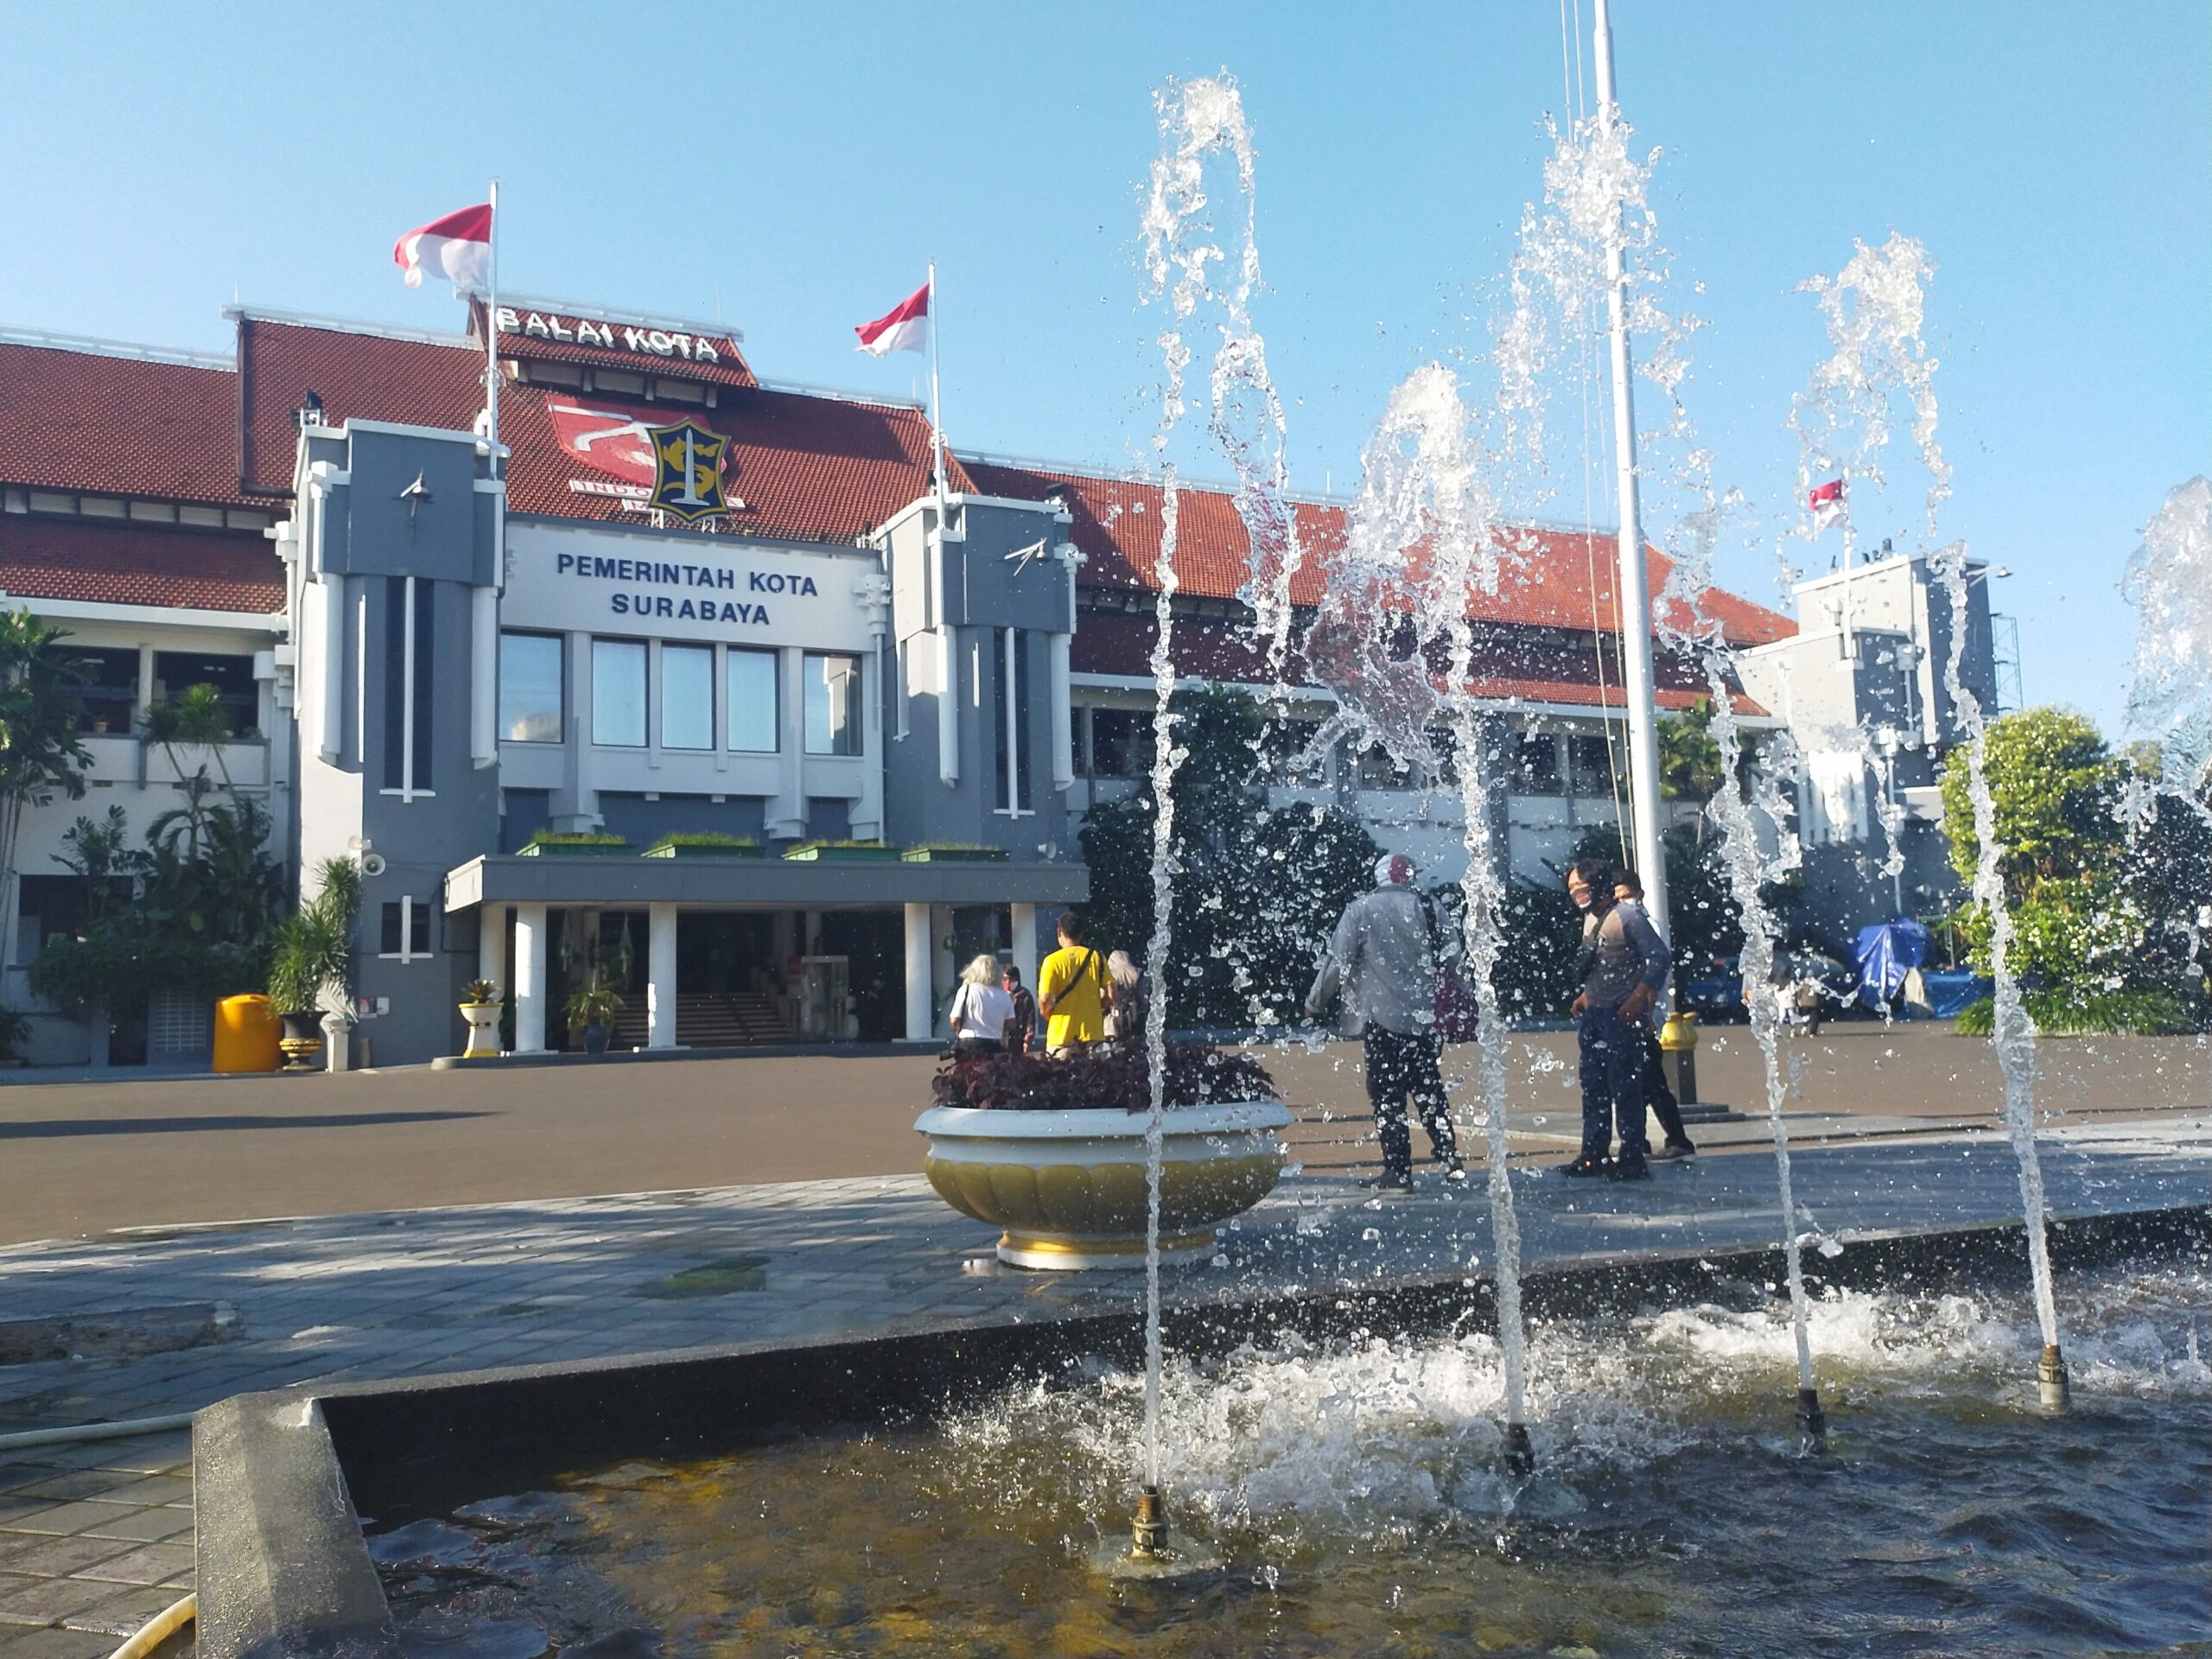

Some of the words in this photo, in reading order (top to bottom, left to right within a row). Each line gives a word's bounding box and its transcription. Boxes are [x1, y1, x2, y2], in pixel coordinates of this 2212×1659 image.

[496, 307, 614, 348] BALAI
[624, 326, 719, 363] KOTA
[557, 553, 734, 589] PEMERINTAH
[750, 571, 818, 597] KOTA
[611, 593, 770, 626] SURABAYA
